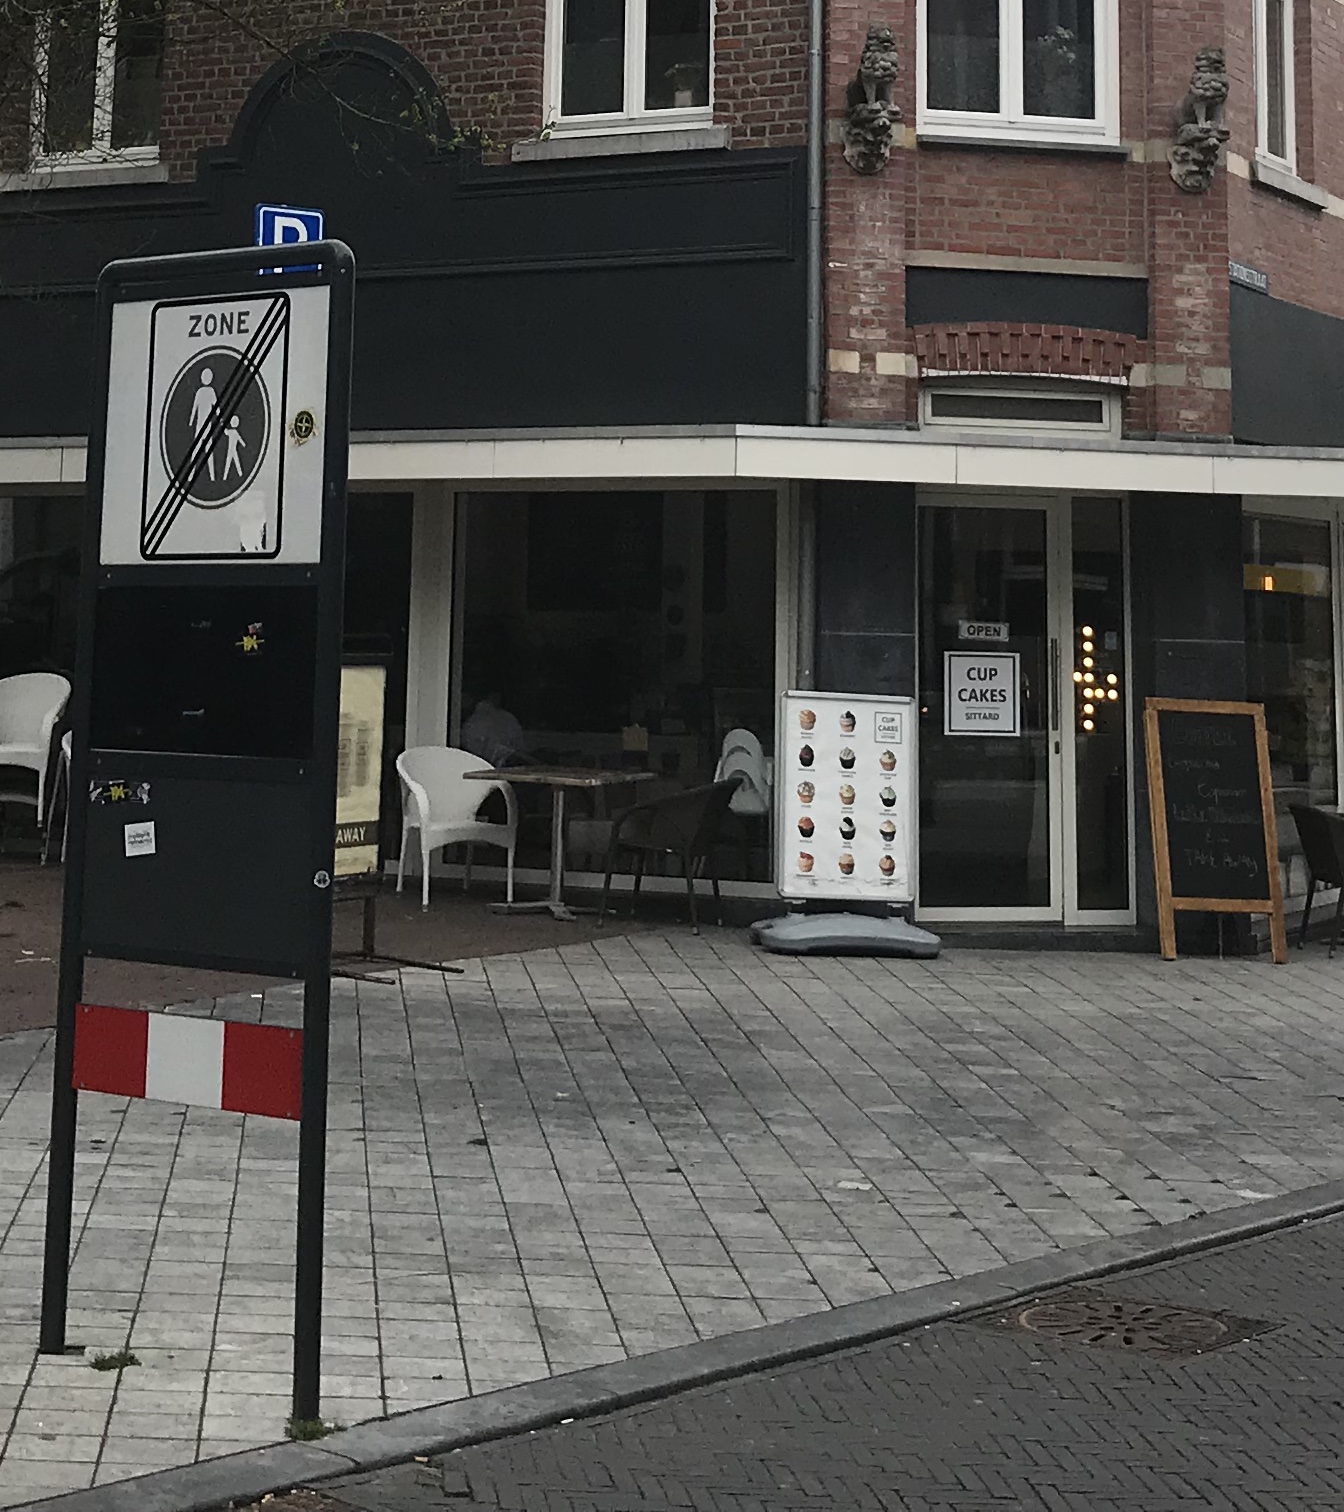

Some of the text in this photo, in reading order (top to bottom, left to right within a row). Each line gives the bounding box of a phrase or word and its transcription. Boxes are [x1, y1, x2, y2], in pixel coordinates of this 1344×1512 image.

[188, 310, 250, 338] ZONE
[967, 624, 1002, 637] OPEN
[966, 667, 998, 681] CUP
[957, 688, 1007, 703] CAKES
[965, 712, 1000, 721] SITTARD
[877, 724, 899, 733] CAKES
[335, 826, 367, 844] AWAY
